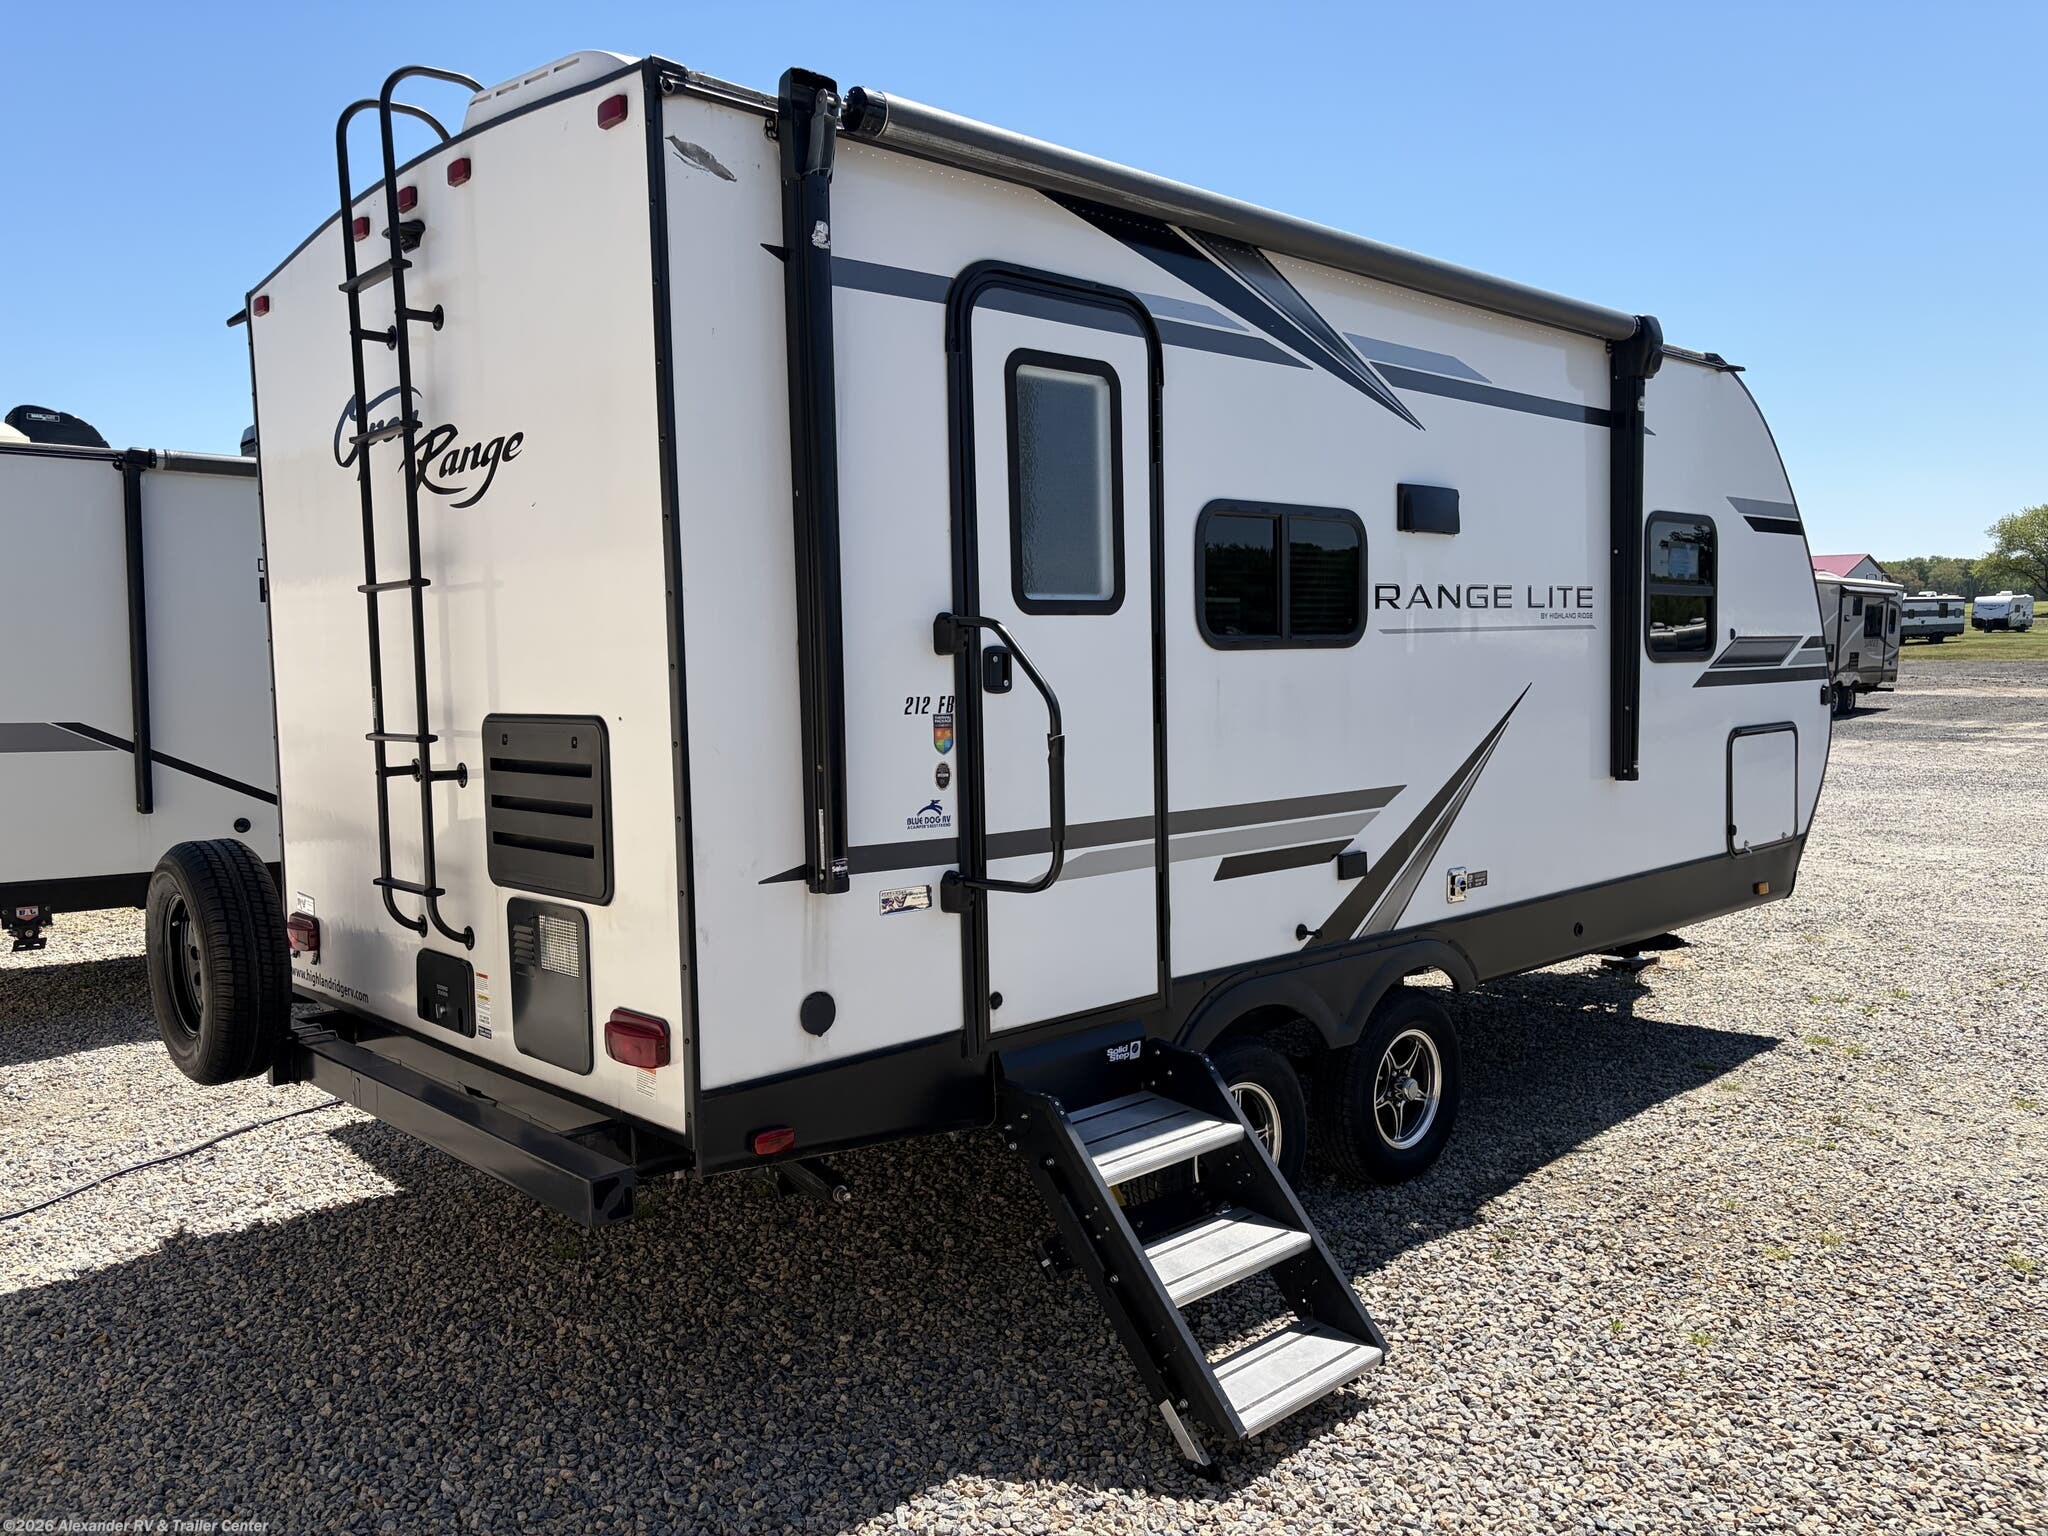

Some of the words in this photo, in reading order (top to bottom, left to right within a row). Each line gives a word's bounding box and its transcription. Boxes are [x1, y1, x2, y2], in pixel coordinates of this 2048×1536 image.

[398, 423, 524, 509] Range
[1374, 583, 1513, 610] RANGE
[1527, 585, 1594, 609] LITE
[904, 696, 931, 715] 212
[938, 695, 955, 714] FB
[906, 817, 923, 826] BLUE
[924, 816, 941, 825] DOG
[1106, 1044, 1129, 1057] Solid
[1109, 1051, 1130, 1062] Step
